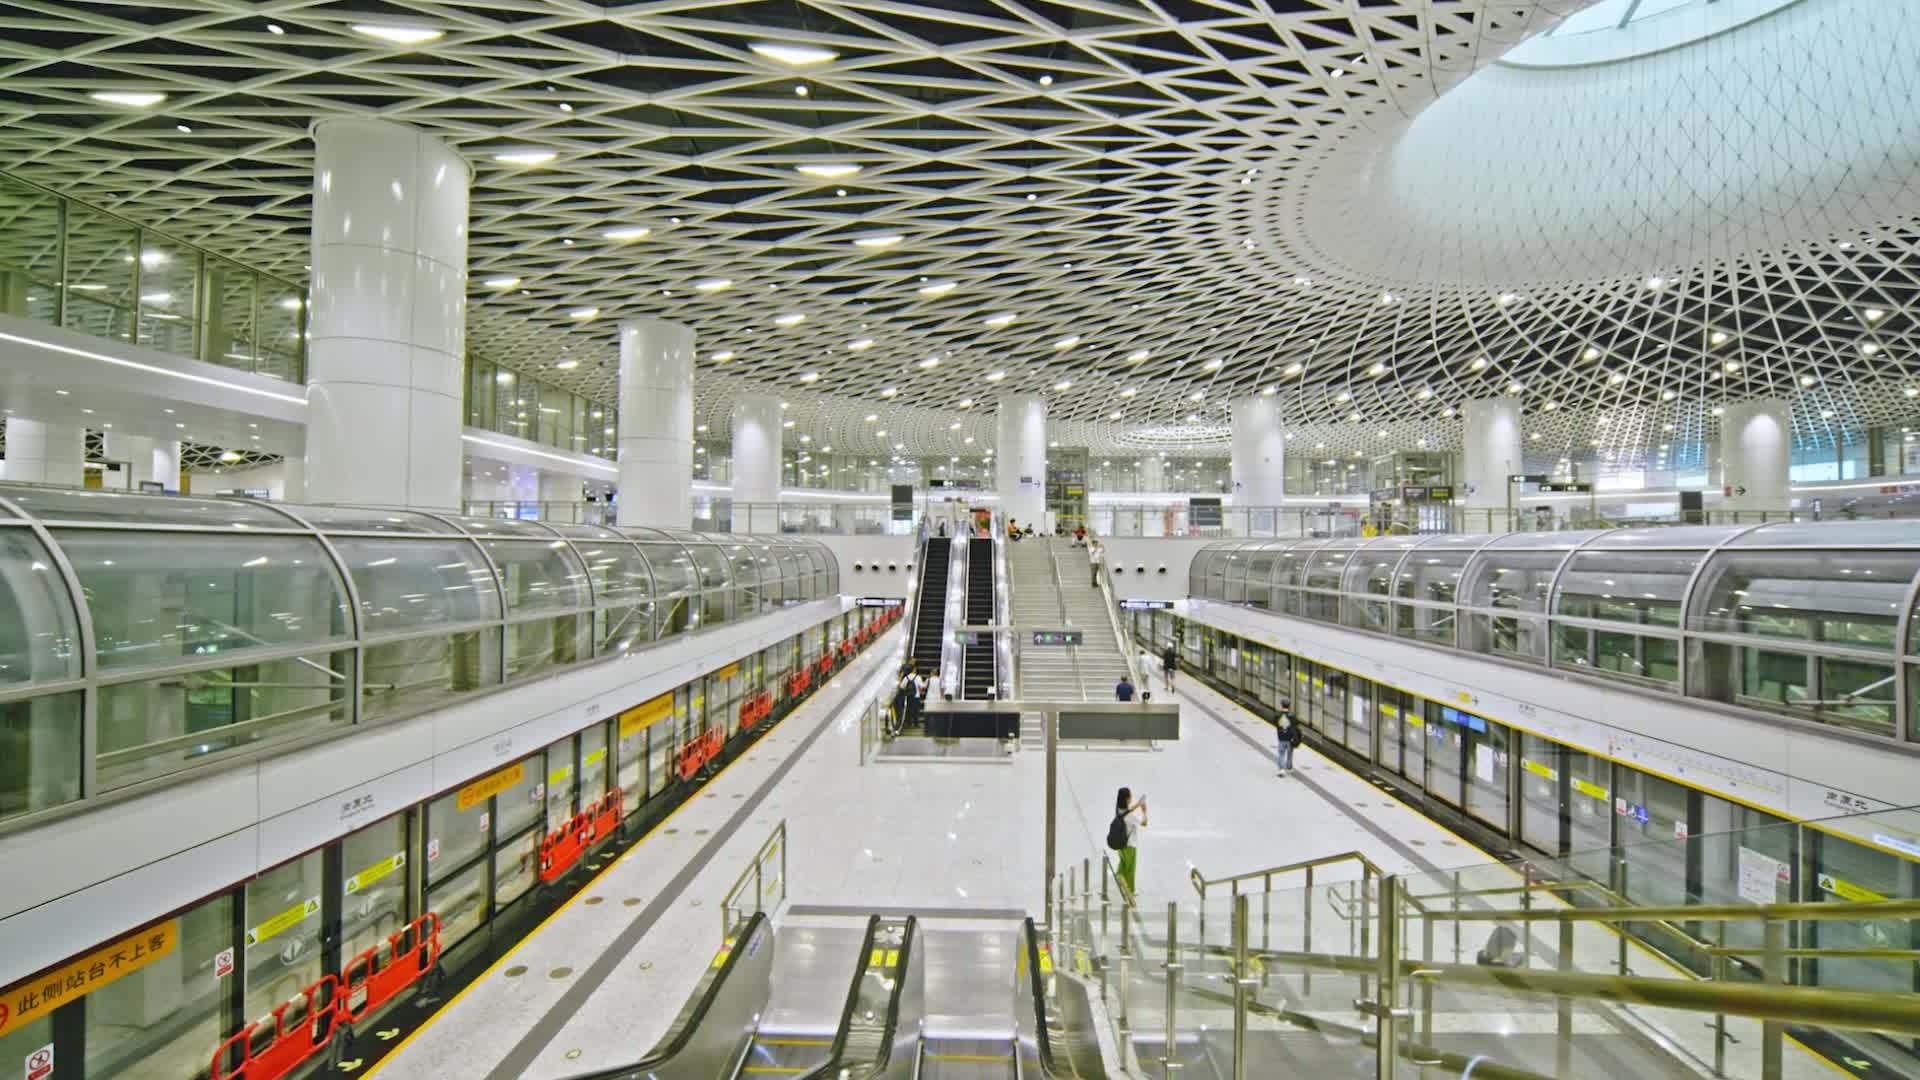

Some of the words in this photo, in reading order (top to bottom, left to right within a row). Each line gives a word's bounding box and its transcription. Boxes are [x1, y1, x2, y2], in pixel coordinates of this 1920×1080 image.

[16, 932, 166, 1017] 此侧站台不上客
